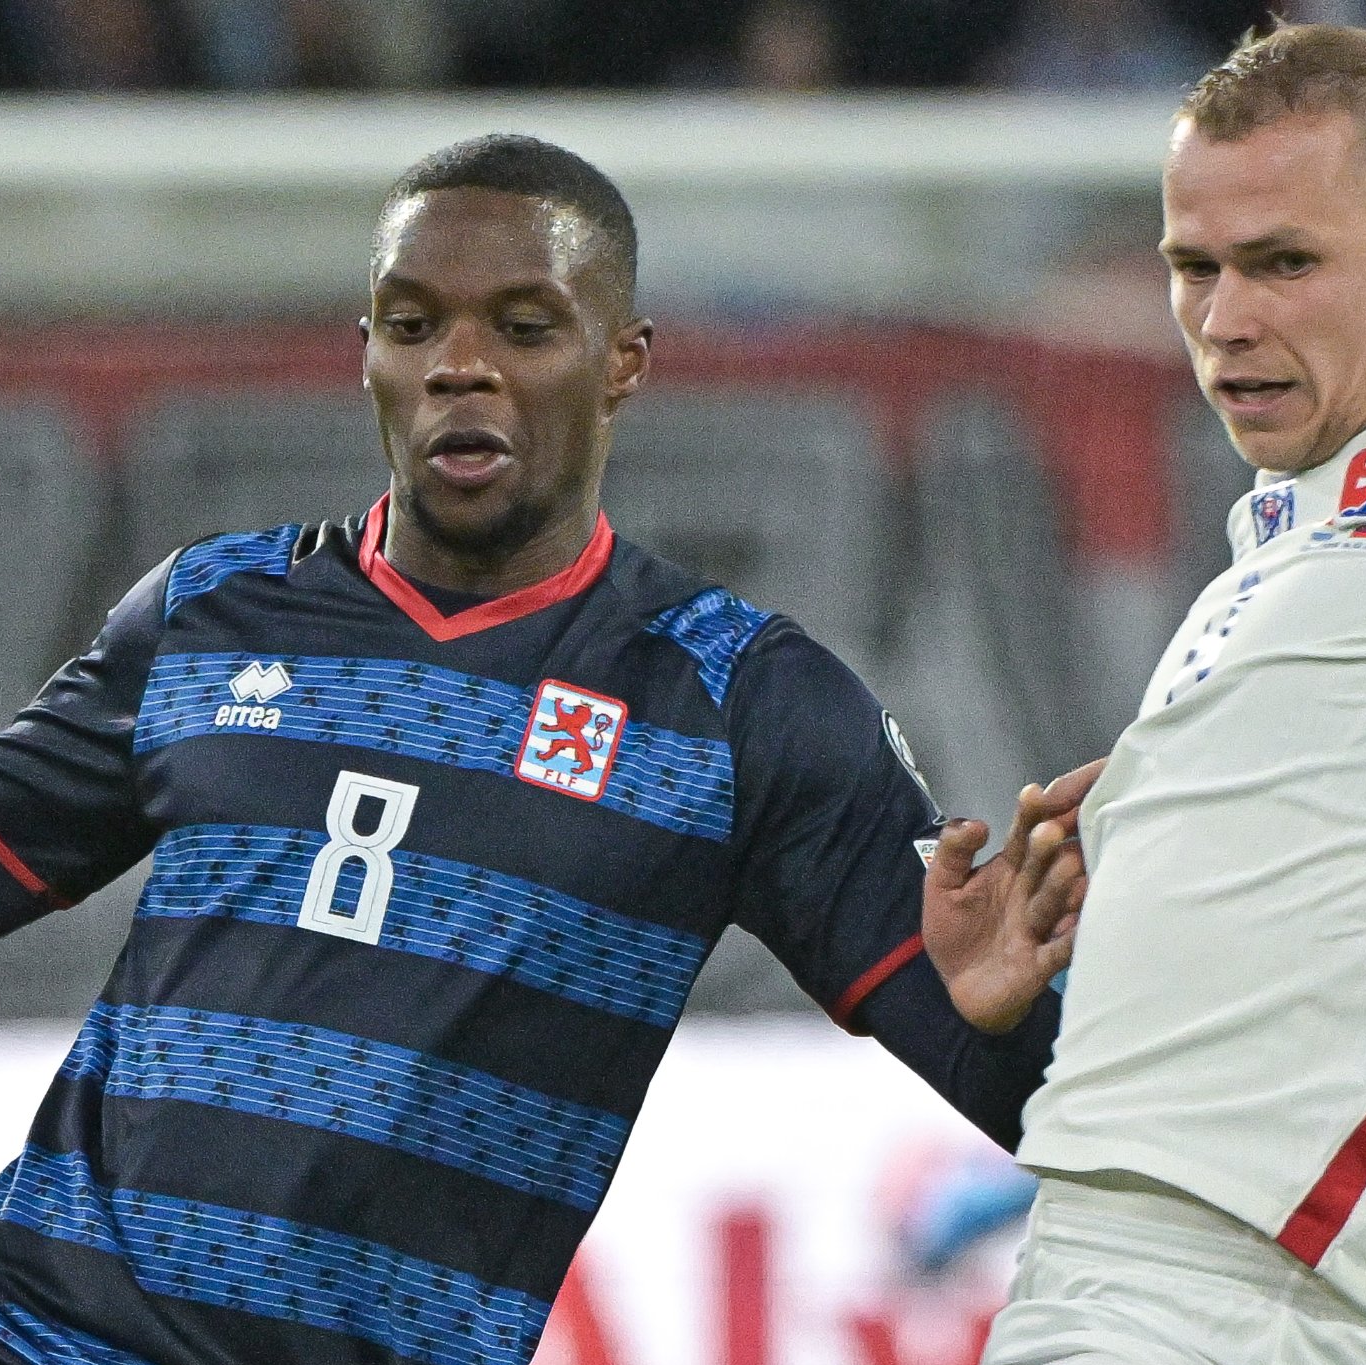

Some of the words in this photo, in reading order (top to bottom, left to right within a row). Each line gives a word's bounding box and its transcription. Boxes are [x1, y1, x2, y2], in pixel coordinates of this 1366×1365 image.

[214, 704, 282, 730] errea
[543, 769, 578, 788] FLF
[297, 770, 420, 946] 8
